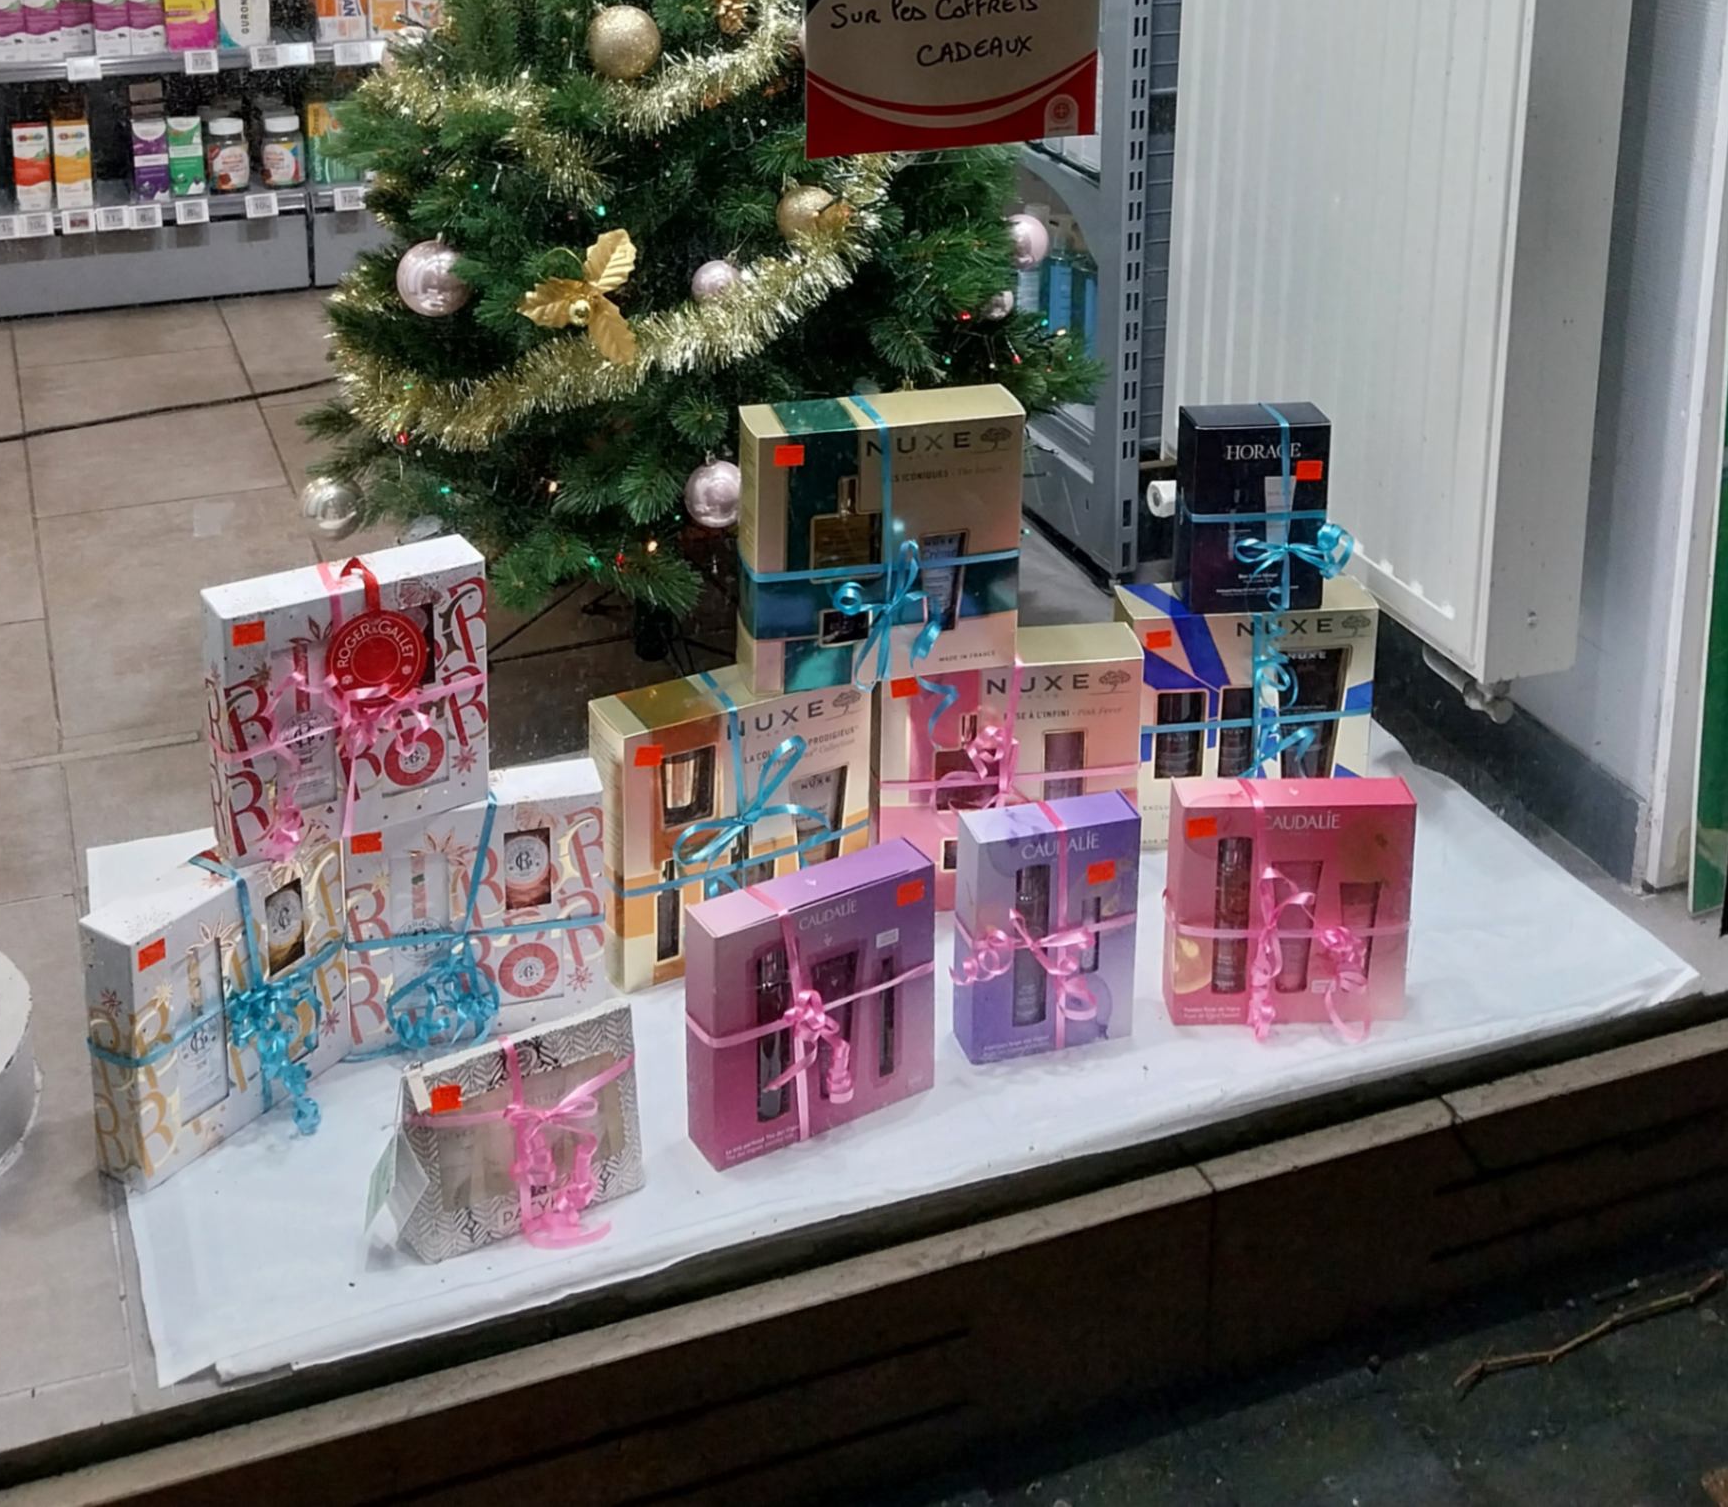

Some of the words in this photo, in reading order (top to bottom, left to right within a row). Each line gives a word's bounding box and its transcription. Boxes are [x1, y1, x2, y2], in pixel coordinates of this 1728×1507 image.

[916, 35, 1034, 68] CADEAUX
[866, 431, 971, 457] NUXE
[1226, 443, 1301, 460] HORACE
[337, 623, 372, 668] ROGER
[377, 620, 414, 658] GALLET
[1021, 830, 1100, 860] CAUALIE
